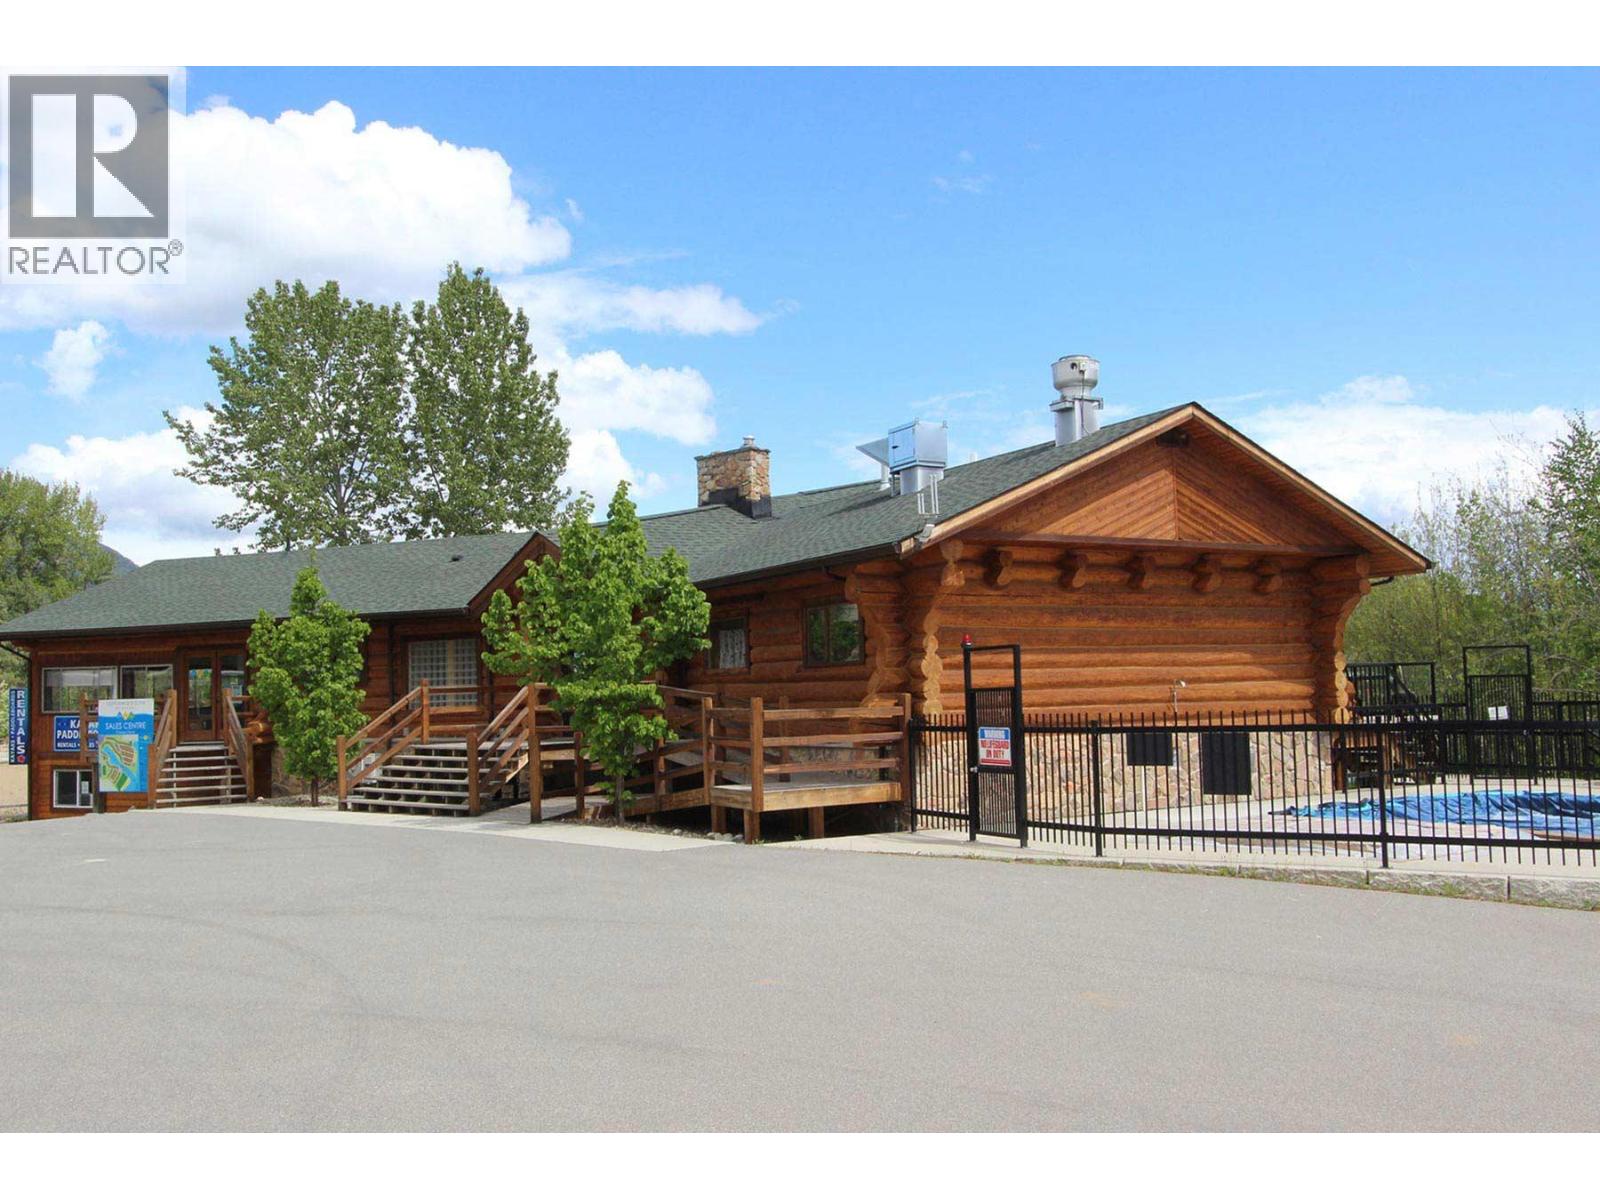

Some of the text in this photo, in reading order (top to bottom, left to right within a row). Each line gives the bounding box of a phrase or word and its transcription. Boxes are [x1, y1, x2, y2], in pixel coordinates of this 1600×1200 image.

[17, 690, 26, 755] RENTALS
[105, 721, 146, 730] SALES CENTRE
